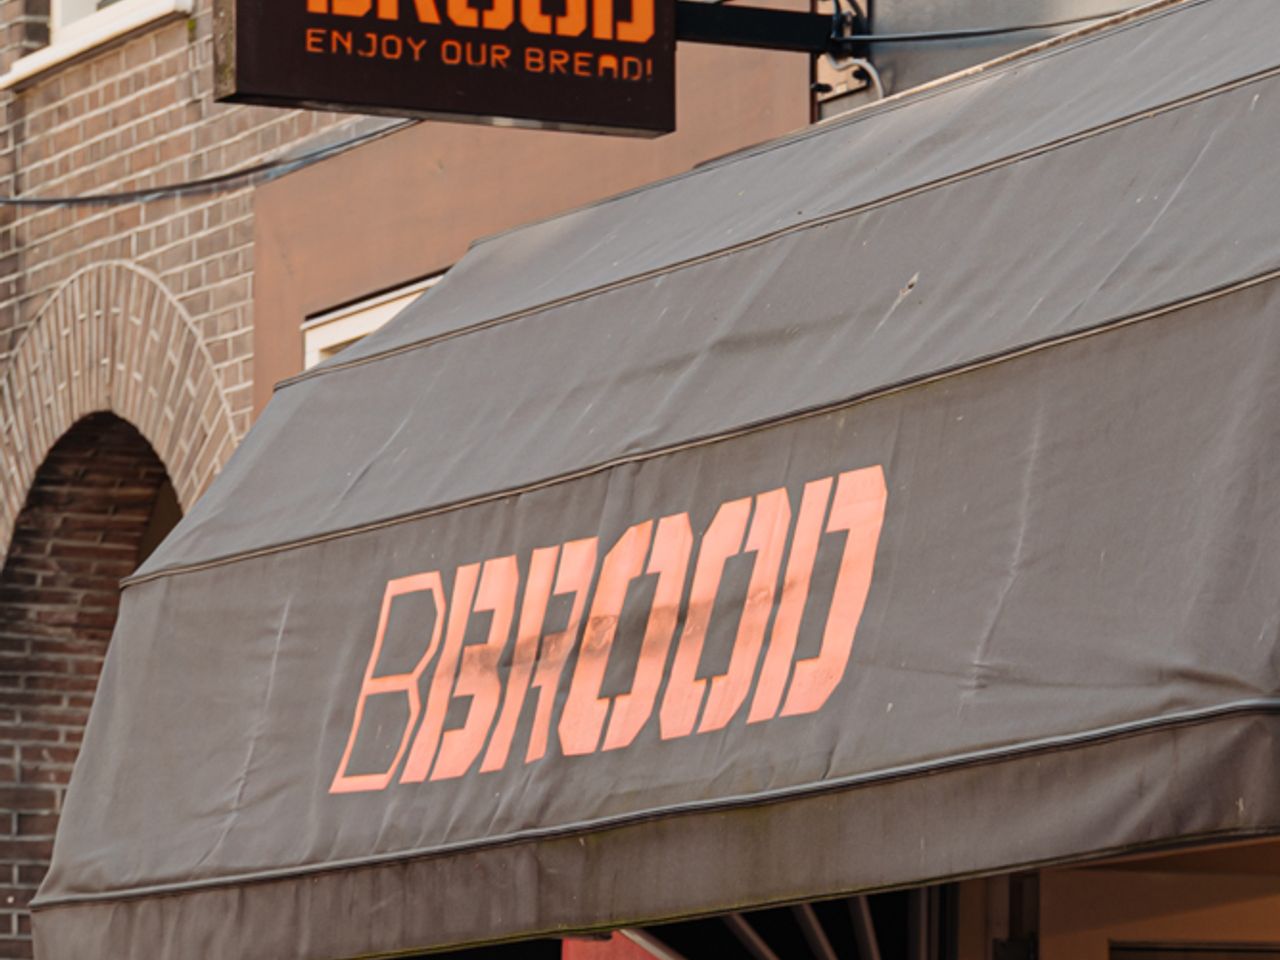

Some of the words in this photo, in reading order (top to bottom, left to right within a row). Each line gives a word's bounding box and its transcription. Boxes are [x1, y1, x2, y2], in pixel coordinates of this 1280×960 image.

[305, 27, 432, 63] ENJOY
[440, 39, 512, 69] OUR
[524, 47, 653, 82] BREAD!
[329, 464, 888, 793] BBROOD
